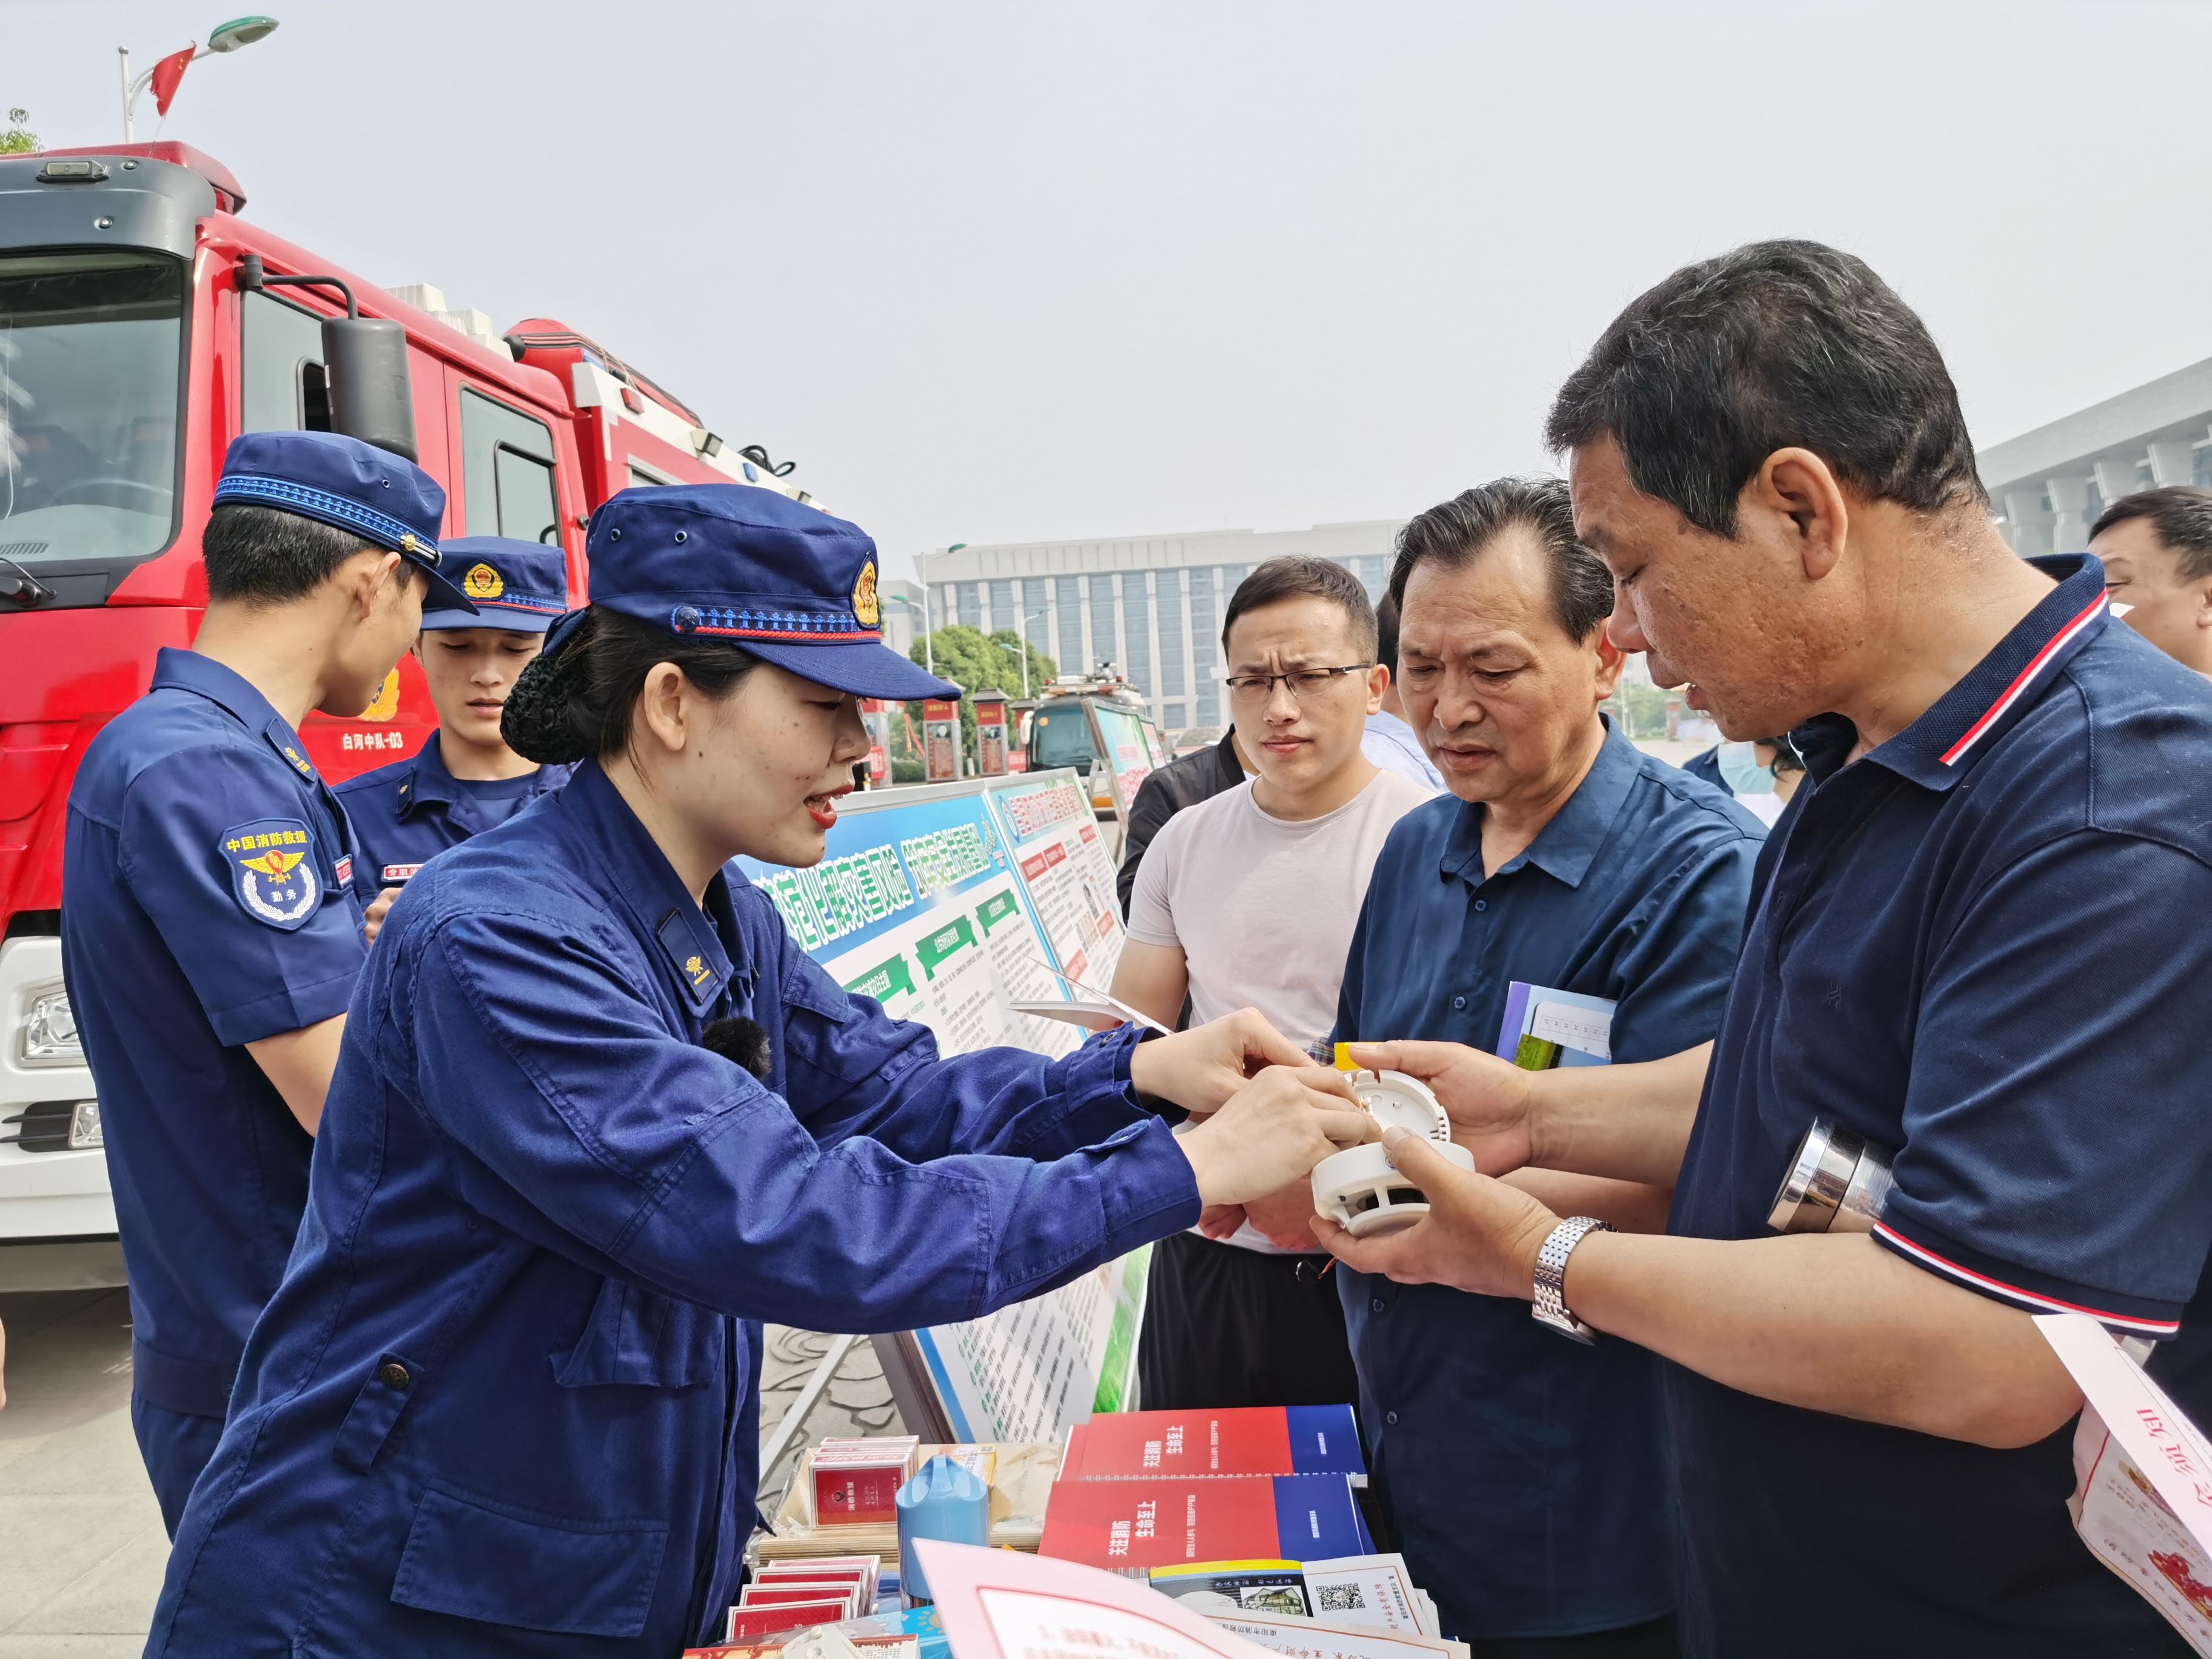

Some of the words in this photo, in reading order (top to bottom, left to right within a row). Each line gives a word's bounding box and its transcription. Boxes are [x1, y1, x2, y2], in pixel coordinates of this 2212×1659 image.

[343, 732, 404, 751] 白河中队-03
[226, 830, 307, 853] 中国消防救援
[270, 889, 297, 902] 勤务
[1165, 1425, 1184, 1454] 生命至上
[1142, 1440, 1162, 1467] 关注消防
[1134, 1500, 1156, 1538] 生命至上
[1108, 1520, 1131, 1556] 关注消防
[1217, 1623, 1277, 1637] 南阳市消防救援
